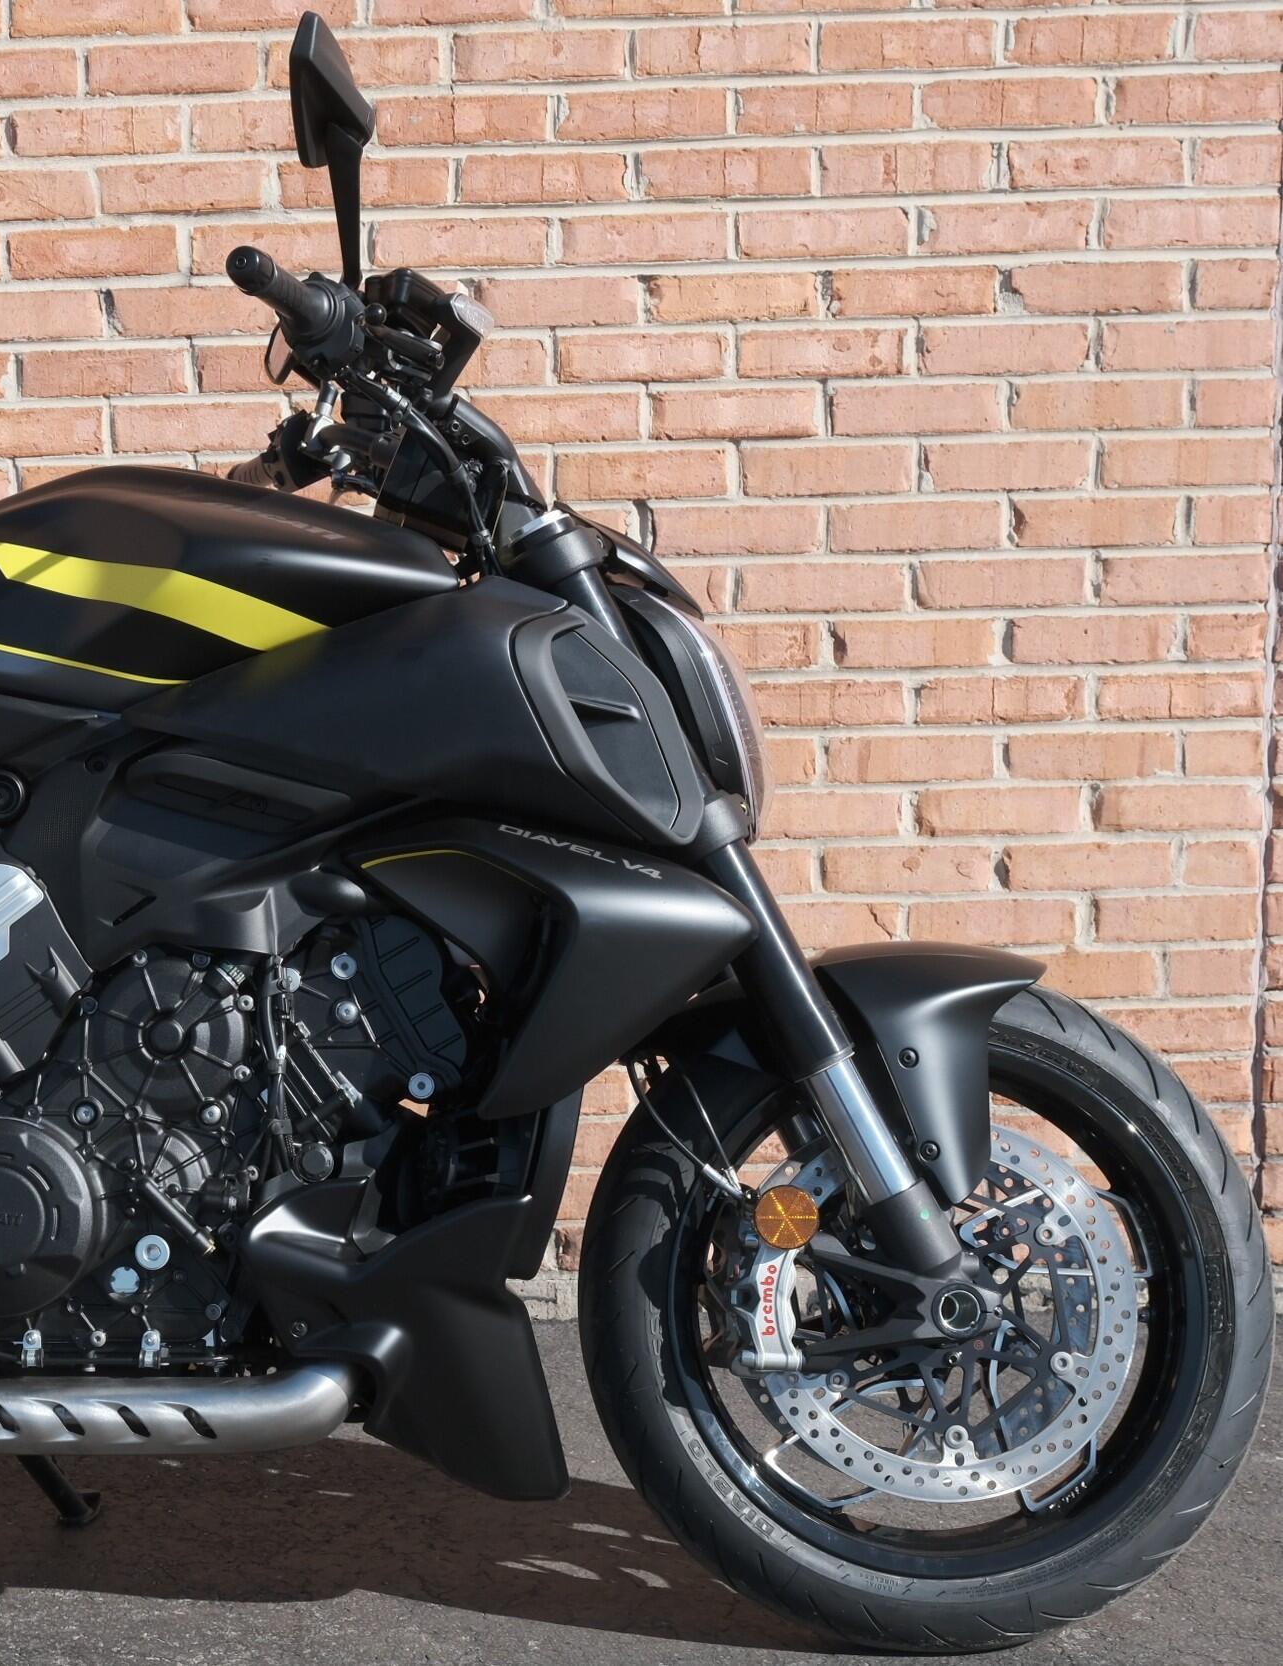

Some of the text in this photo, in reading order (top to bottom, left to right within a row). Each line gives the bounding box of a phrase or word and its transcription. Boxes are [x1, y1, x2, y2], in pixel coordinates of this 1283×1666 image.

[498, 824, 663, 880] DIAVEL V4
[760, 1264, 778, 1336] brembo
[688, 1438, 776, 1540] DIABLO
